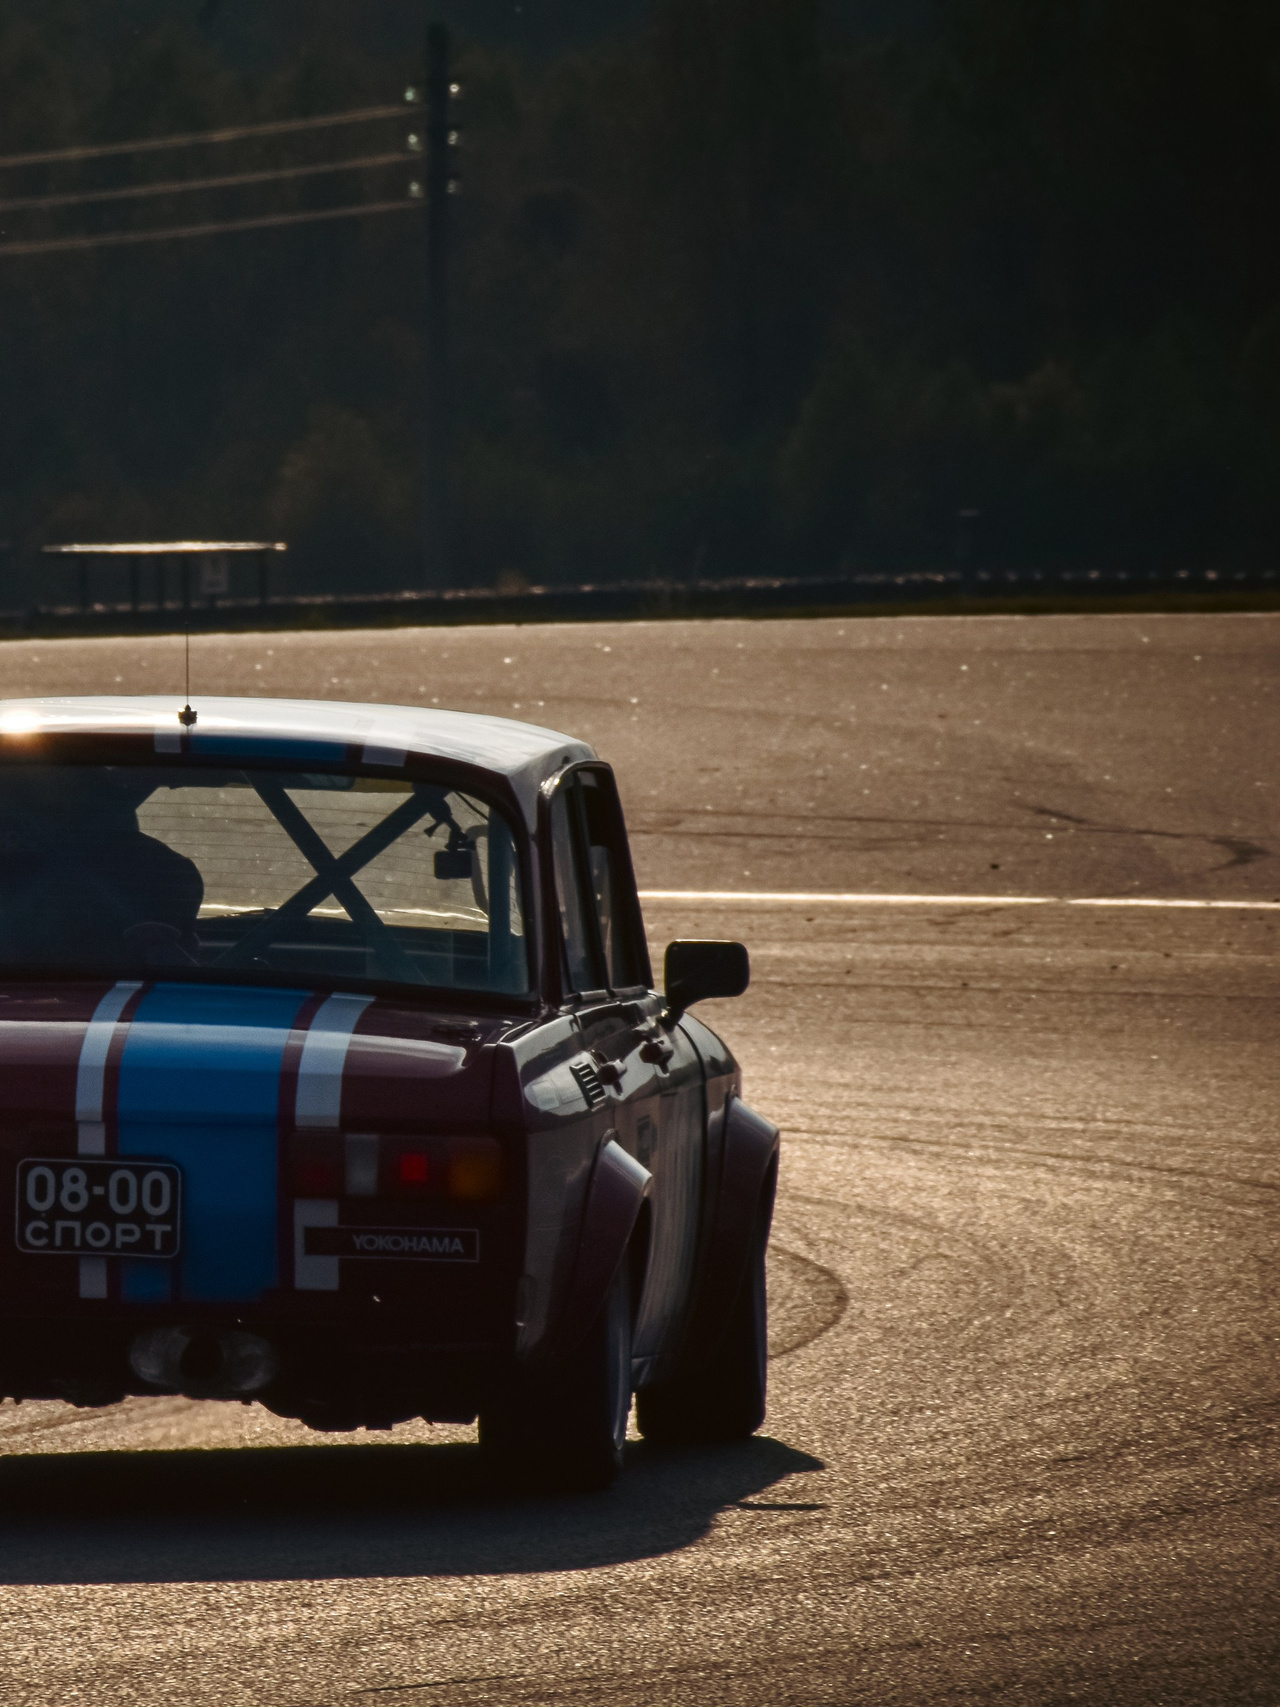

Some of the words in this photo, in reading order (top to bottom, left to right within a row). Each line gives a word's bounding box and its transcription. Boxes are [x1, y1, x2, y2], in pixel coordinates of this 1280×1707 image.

[26, 1166, 171, 1216] 08-00
[24, 1219, 172, 1251] СПОРТ
[352, 1234, 464, 1254] YOKOHAMA
